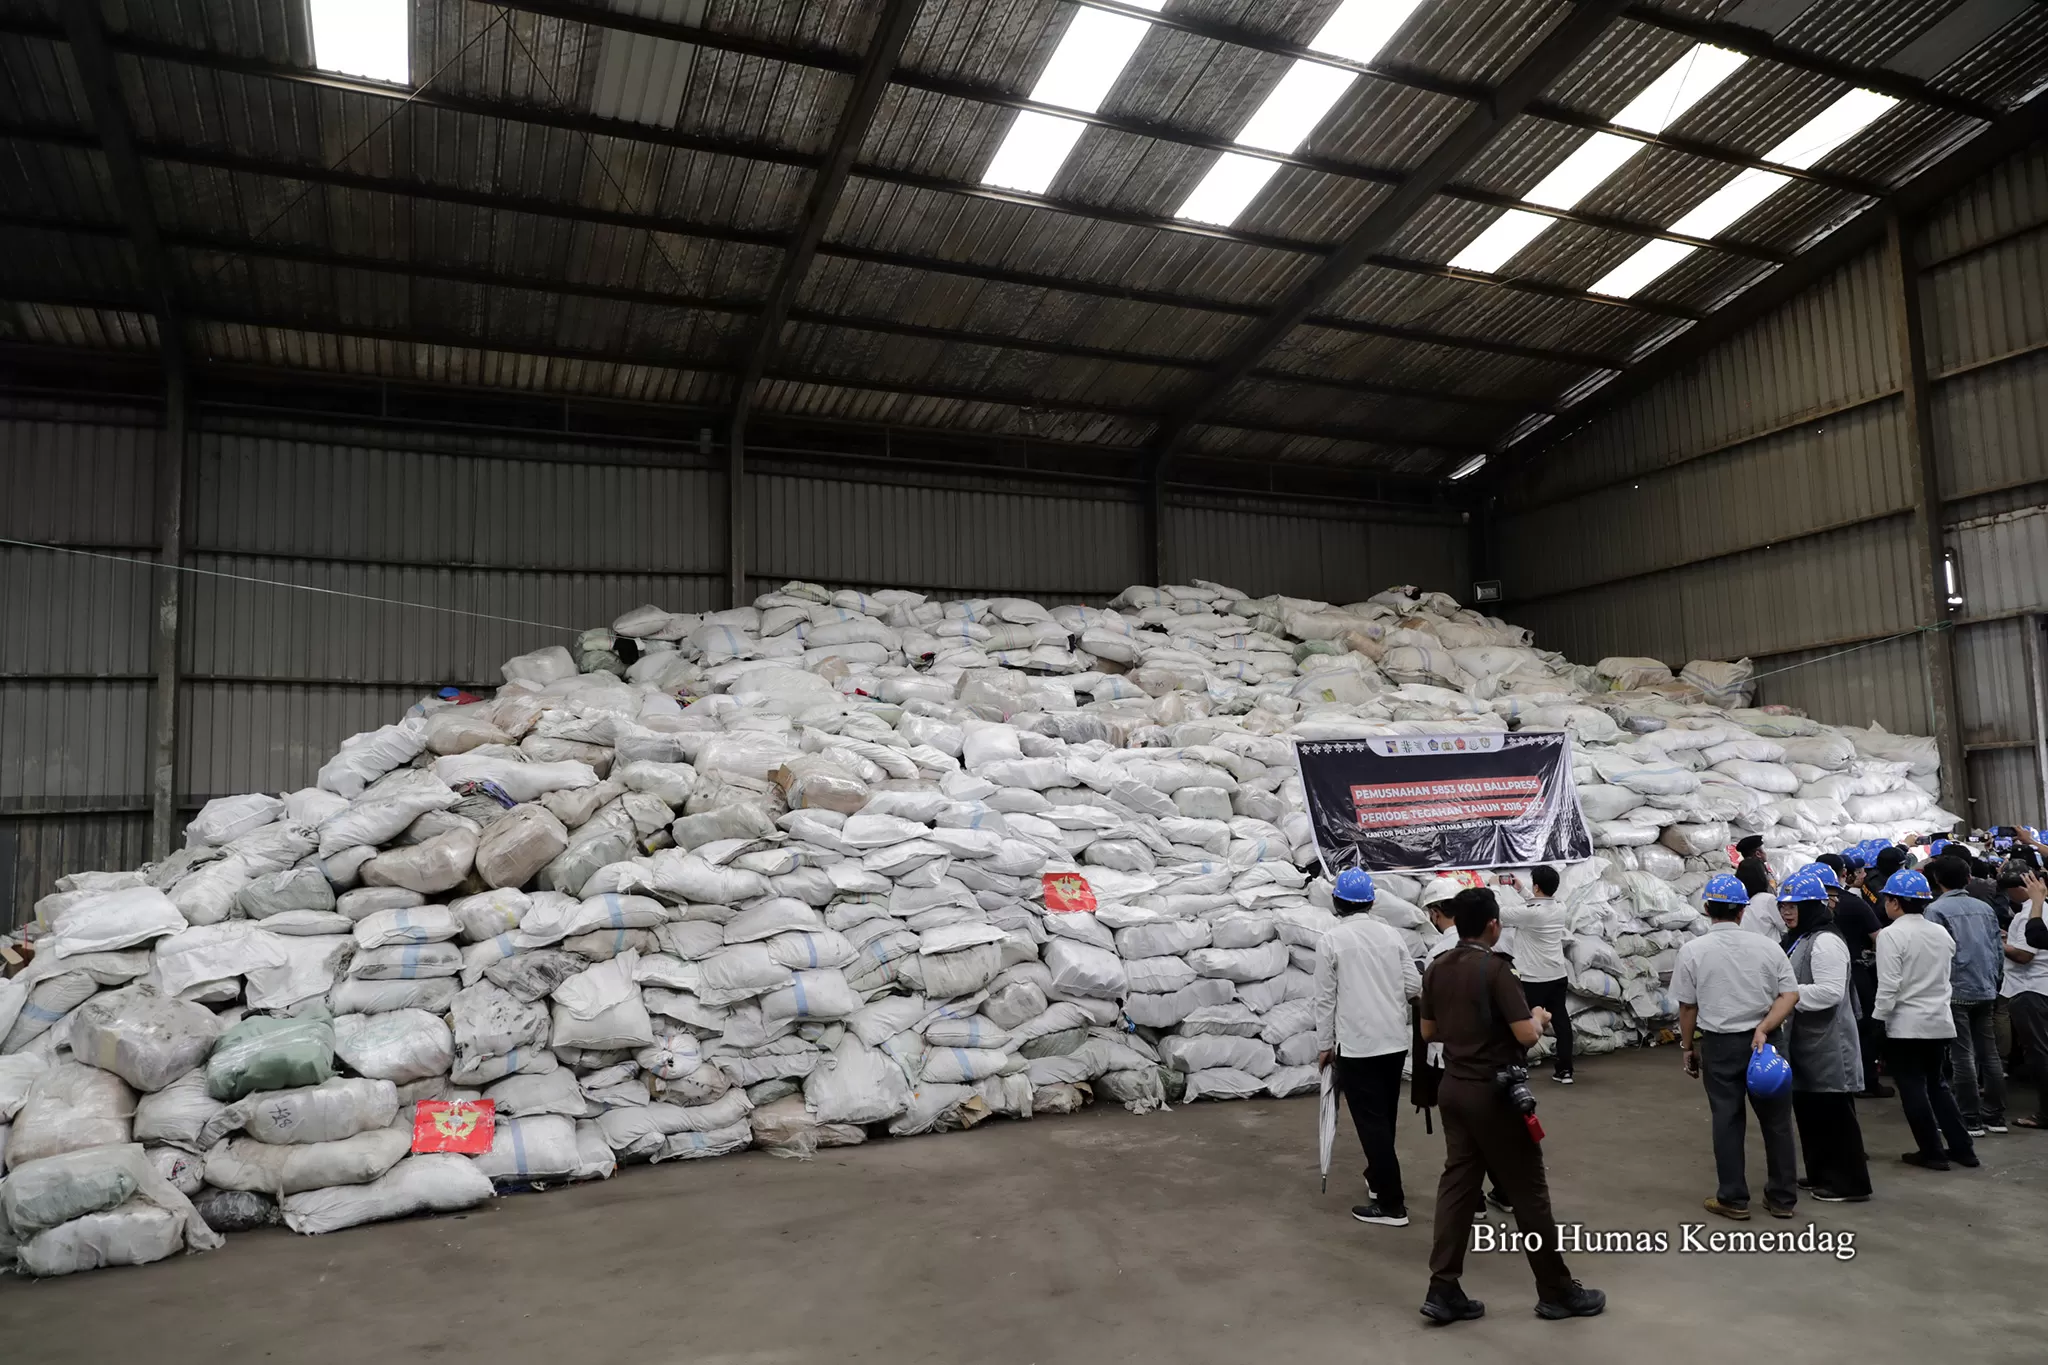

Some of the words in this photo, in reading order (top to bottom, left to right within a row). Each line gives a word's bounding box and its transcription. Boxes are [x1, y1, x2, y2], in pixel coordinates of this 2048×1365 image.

[1355, 786, 1430, 800] PEMUSNAHAN
[1432, 785, 1456, 795] 5853
[1457, 783, 1482, 793] KOLI
[1484, 780, 1539, 791] BALLPRESS
[1361, 811, 1409, 824] PERIODE
[1410, 806, 1463, 819] TEGAHAN
[1464, 803, 1501, 814] TAHUN
[1365, 830, 1394, 839] KANTOR
[1395, 826, 1437, 837] PELAYANAN
[1437, 823, 1462, 832] UTAMA
[1478, 820, 1493, 828] DAN
